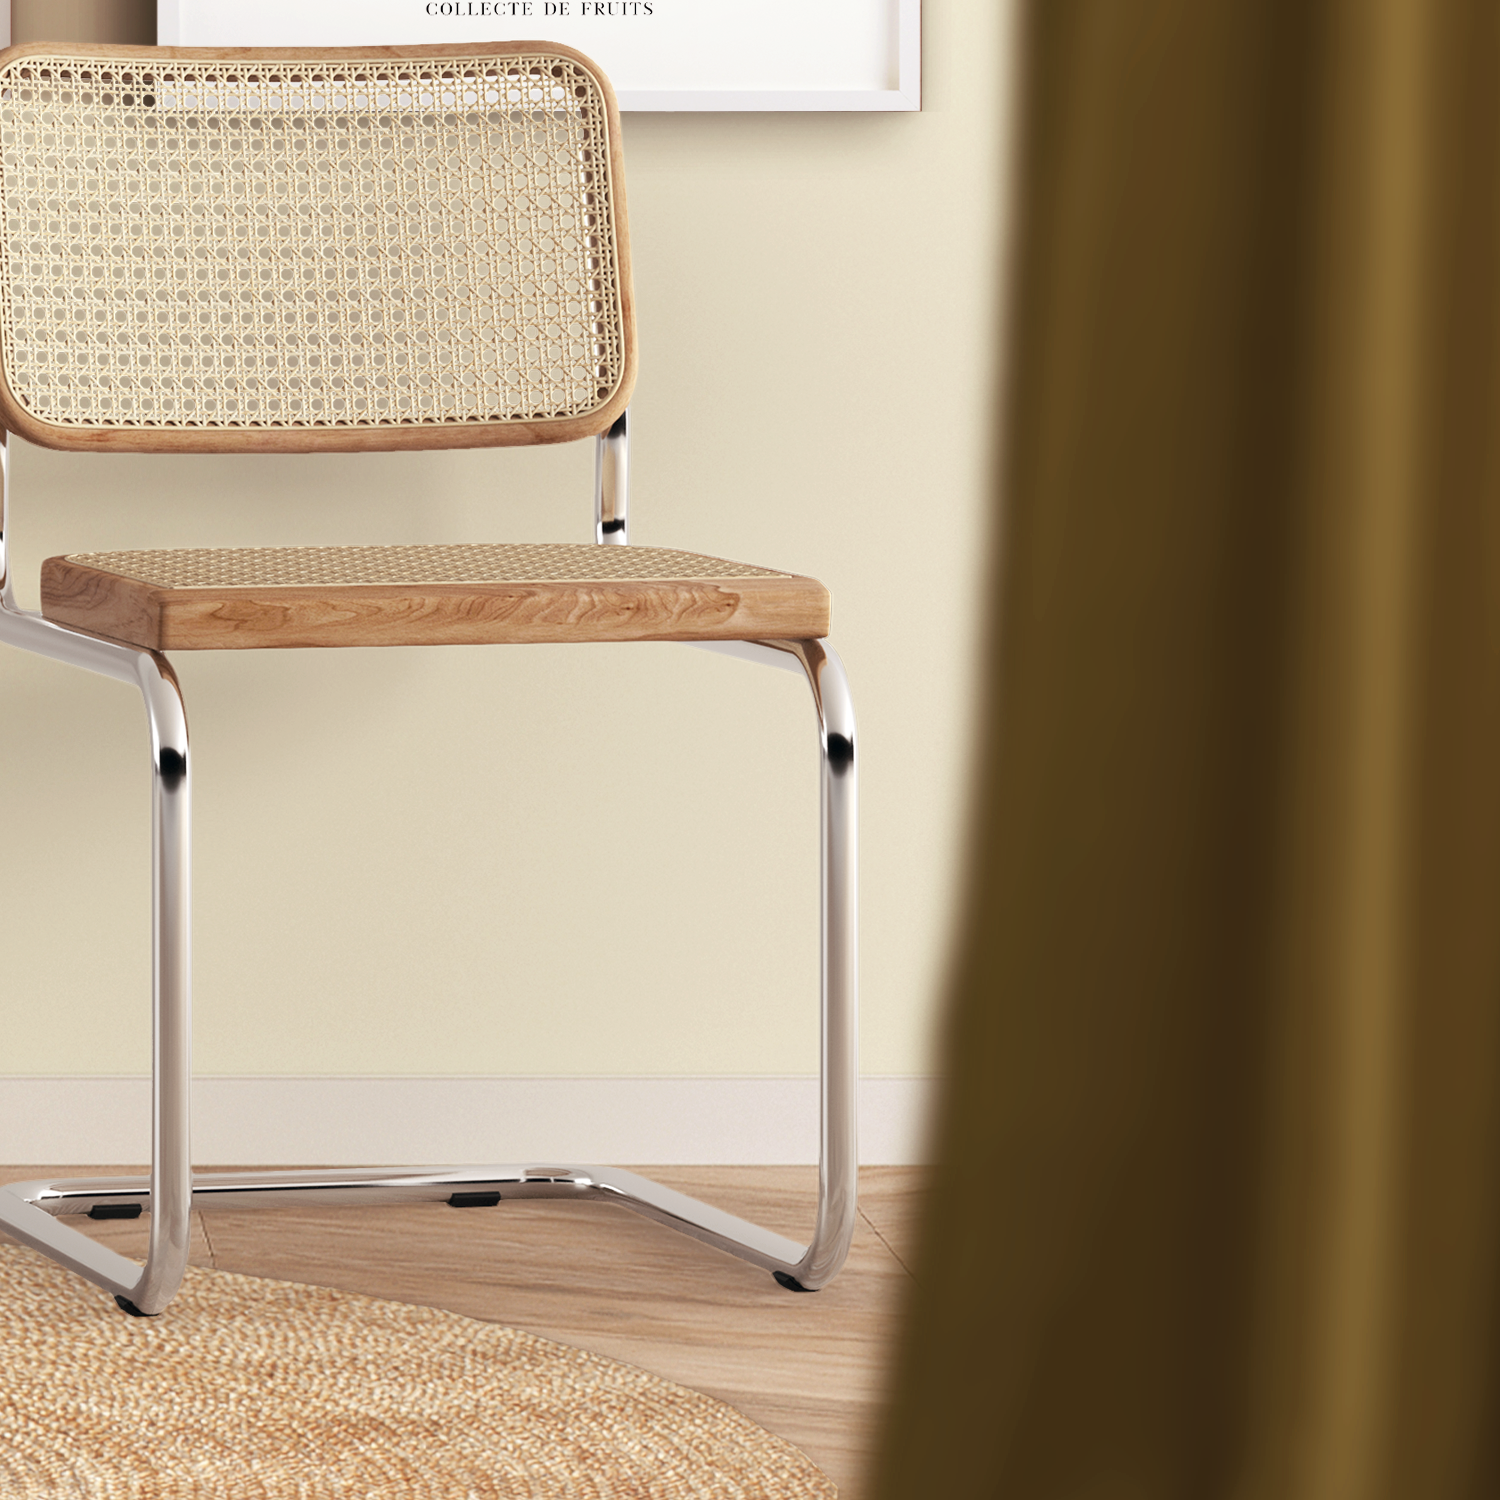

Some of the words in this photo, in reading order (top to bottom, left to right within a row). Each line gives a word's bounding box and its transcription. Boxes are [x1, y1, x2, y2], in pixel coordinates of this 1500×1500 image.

[425, 1, 533, 16] COLLECTE
[544, 1, 570, 16] DE
[581, 1, 654, 16] FRUITS
